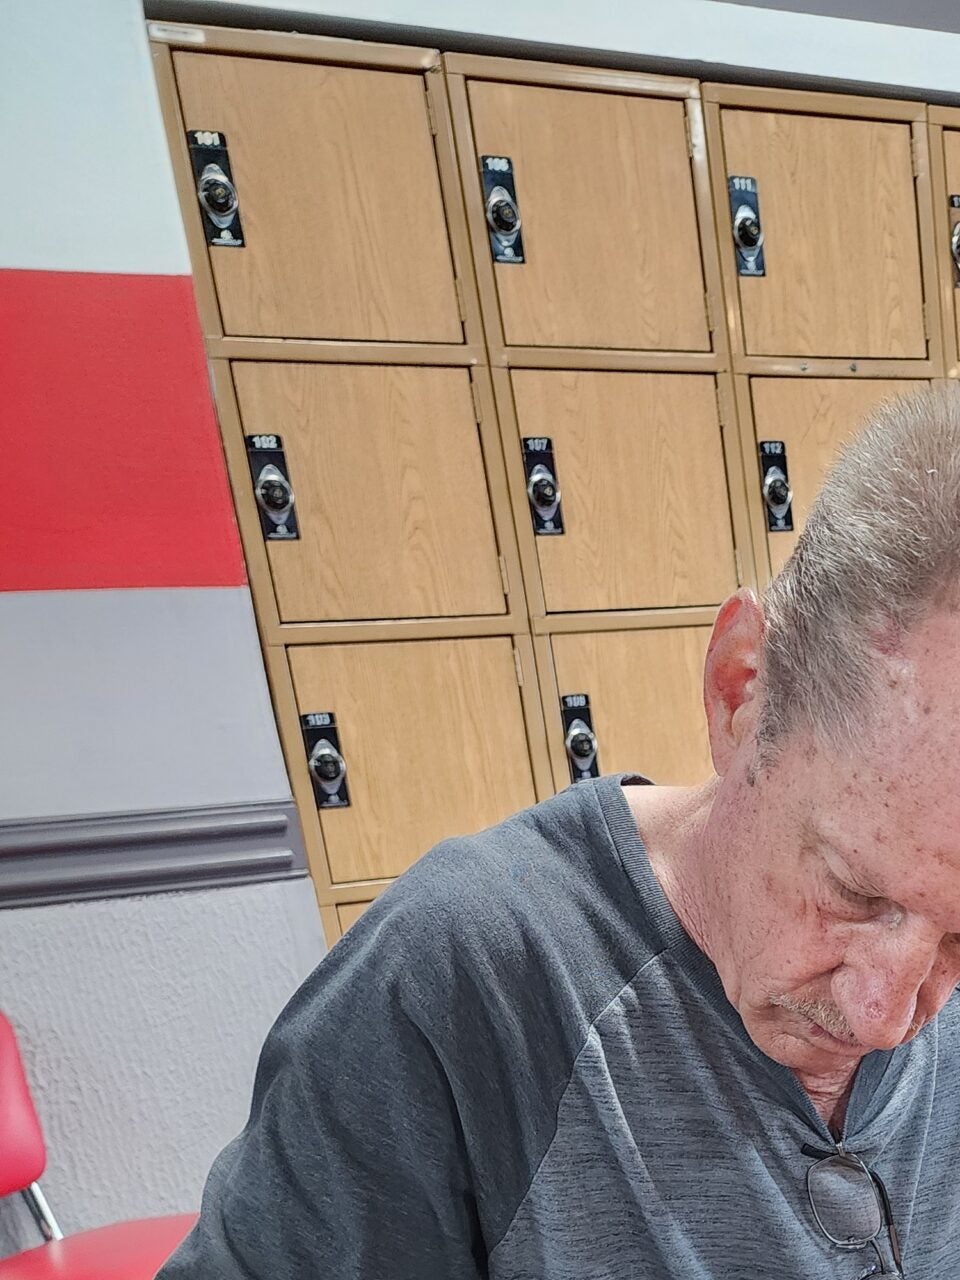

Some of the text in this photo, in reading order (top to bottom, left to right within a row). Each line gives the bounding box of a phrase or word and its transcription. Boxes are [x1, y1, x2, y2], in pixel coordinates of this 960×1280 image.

[194, 131, 220, 146] 101
[732, 177, 752, 191] 111
[252, 435, 277, 449] 102
[526, 438, 548, 451] 107
[763, 442, 782, 454] 112
